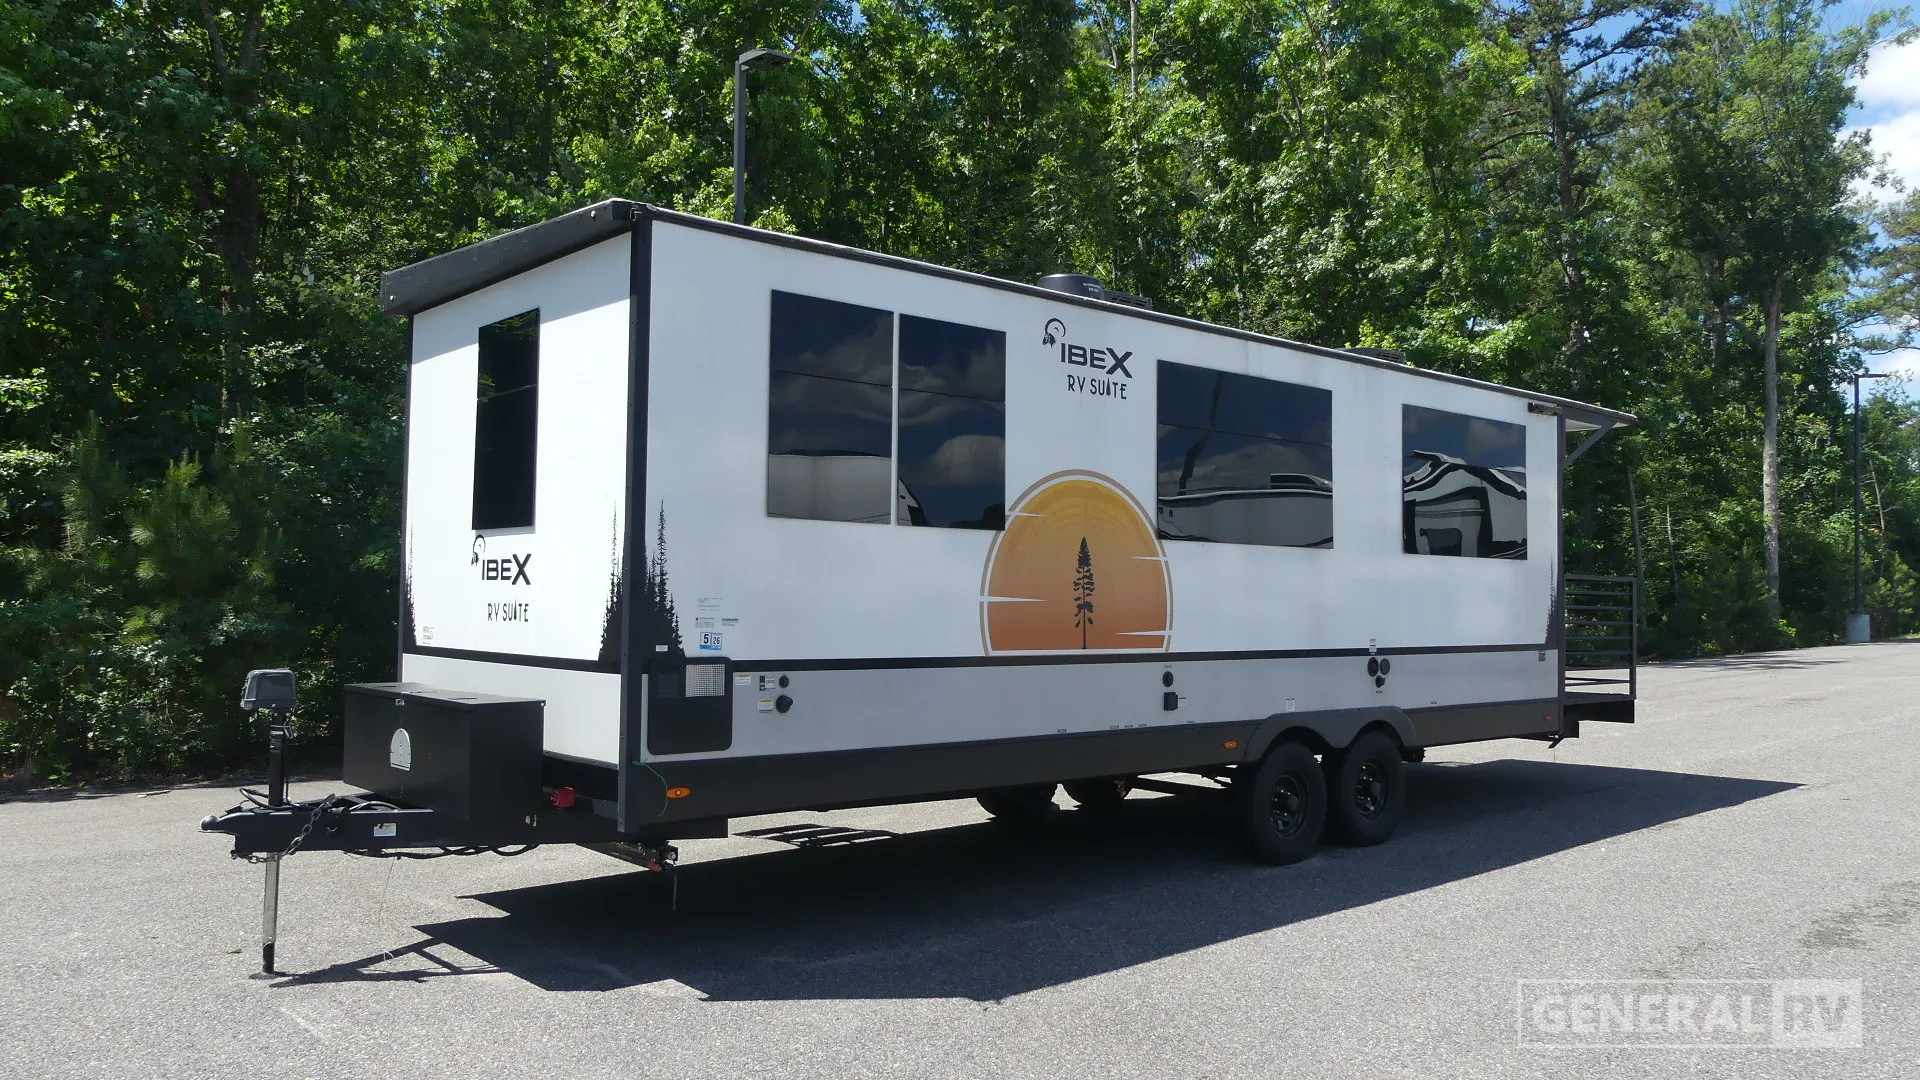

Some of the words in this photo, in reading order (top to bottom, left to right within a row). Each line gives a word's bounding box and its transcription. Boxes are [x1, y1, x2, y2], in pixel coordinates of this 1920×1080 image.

[1060, 342, 1133, 379] IBEX
[1067, 374, 1086, 394] RV
[1090, 377, 1127, 400] SUITE
[481, 553, 532, 585] IBEX
[487, 602, 500, 622] RV
[502, 599, 529, 622] SUITE
[703, 633, 710, 645] 5
[712, 636, 721, 645] 26
